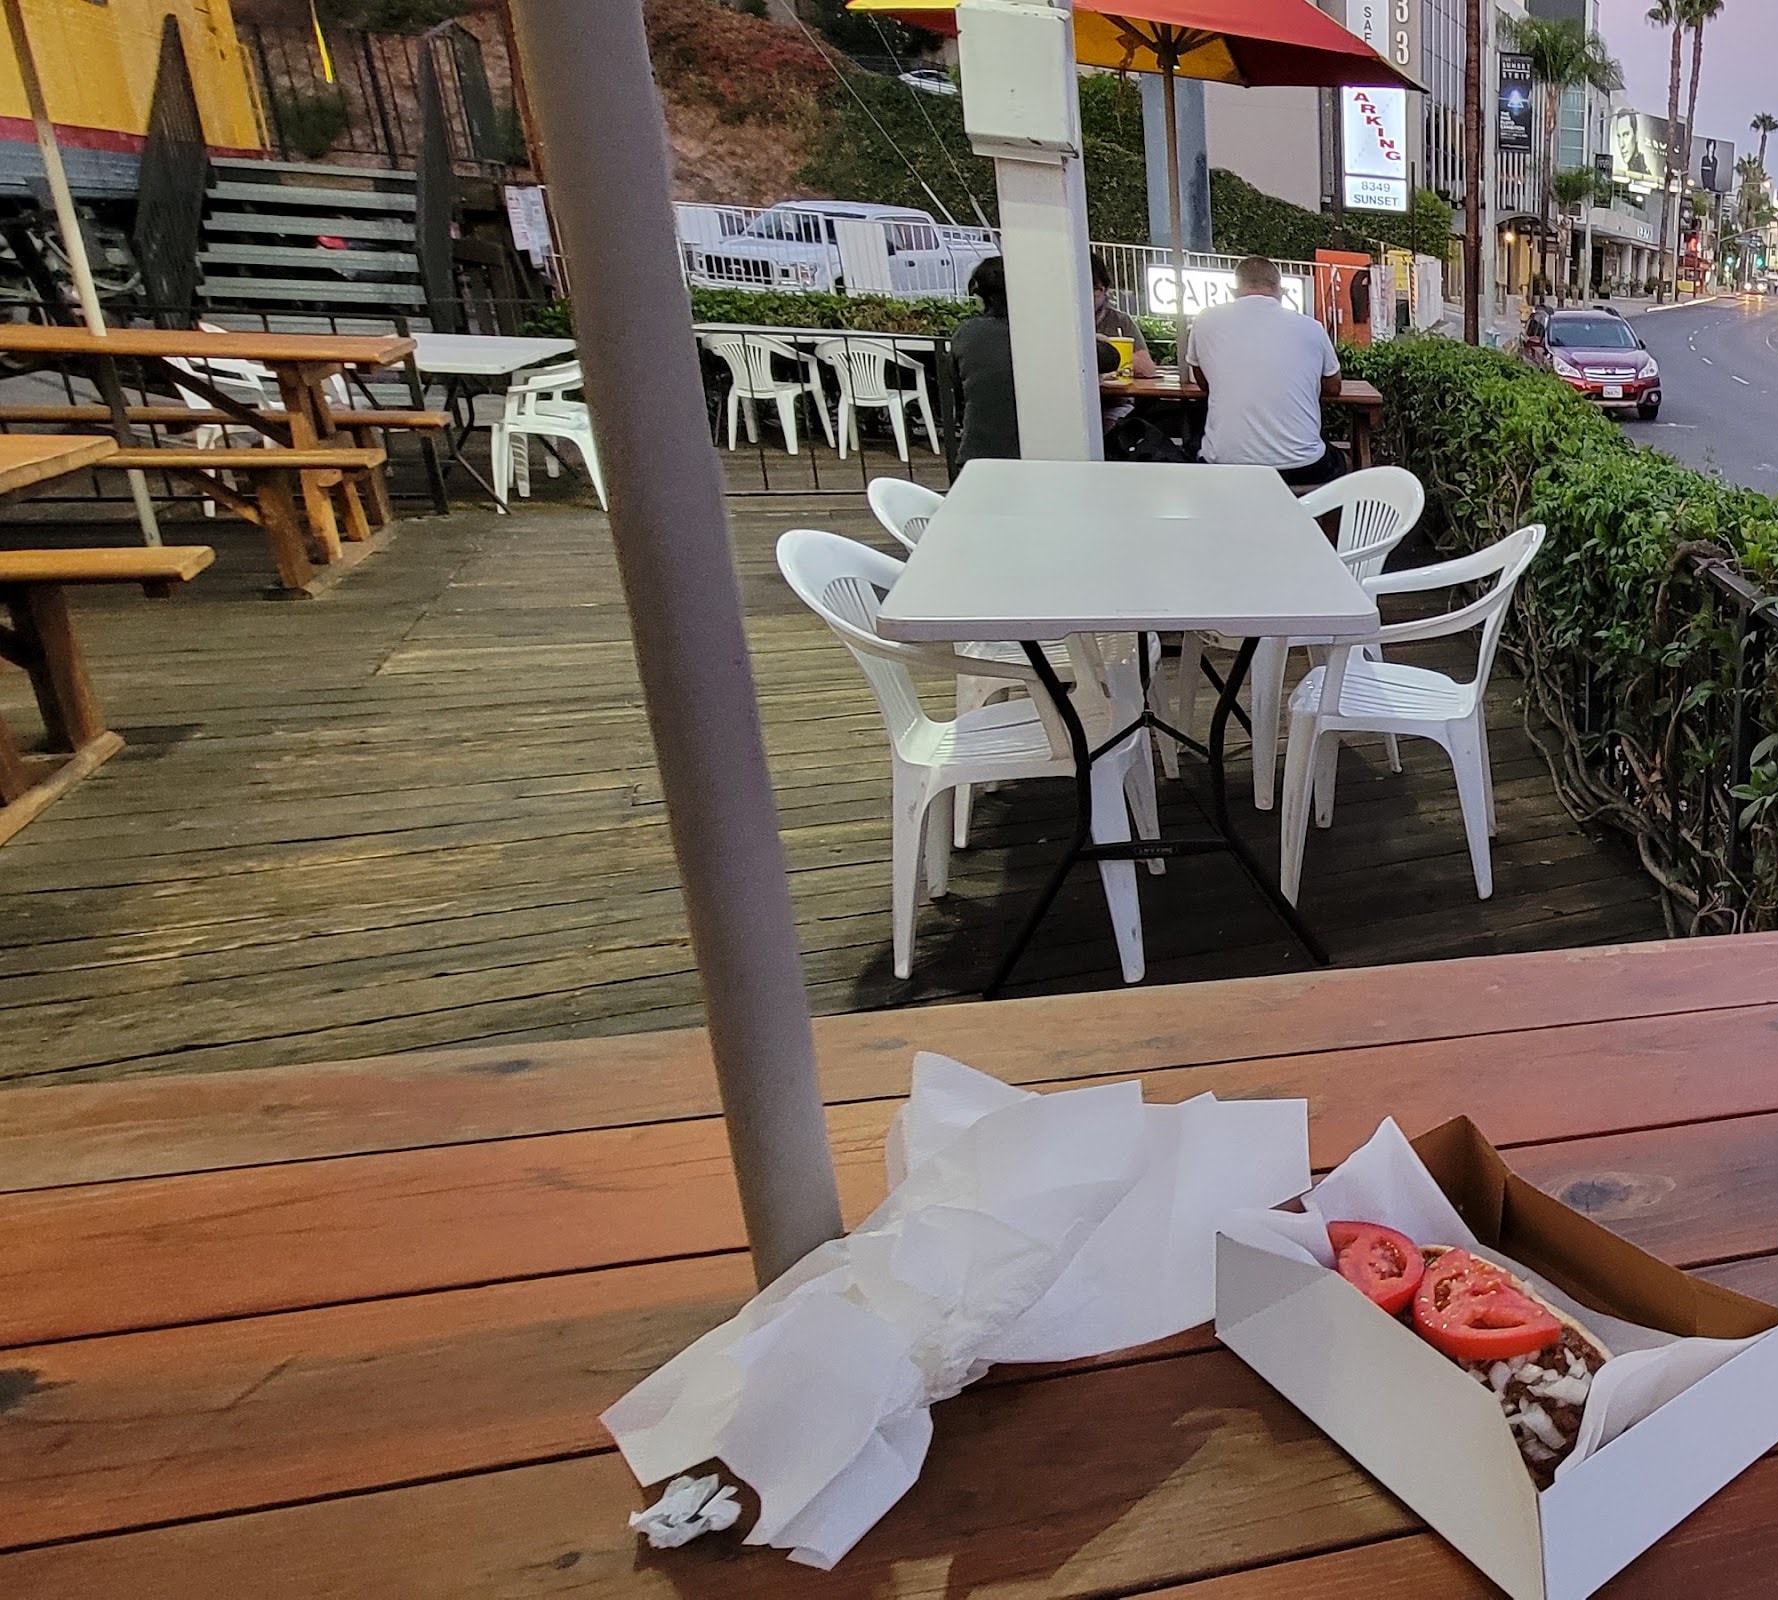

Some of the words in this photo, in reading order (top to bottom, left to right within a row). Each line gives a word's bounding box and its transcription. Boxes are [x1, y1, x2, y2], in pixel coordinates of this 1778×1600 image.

[1353, 92, 1401, 161] ARKING
[1361, 181, 1391, 193] 8349
[1353, 193, 1399, 207] SUNSET
